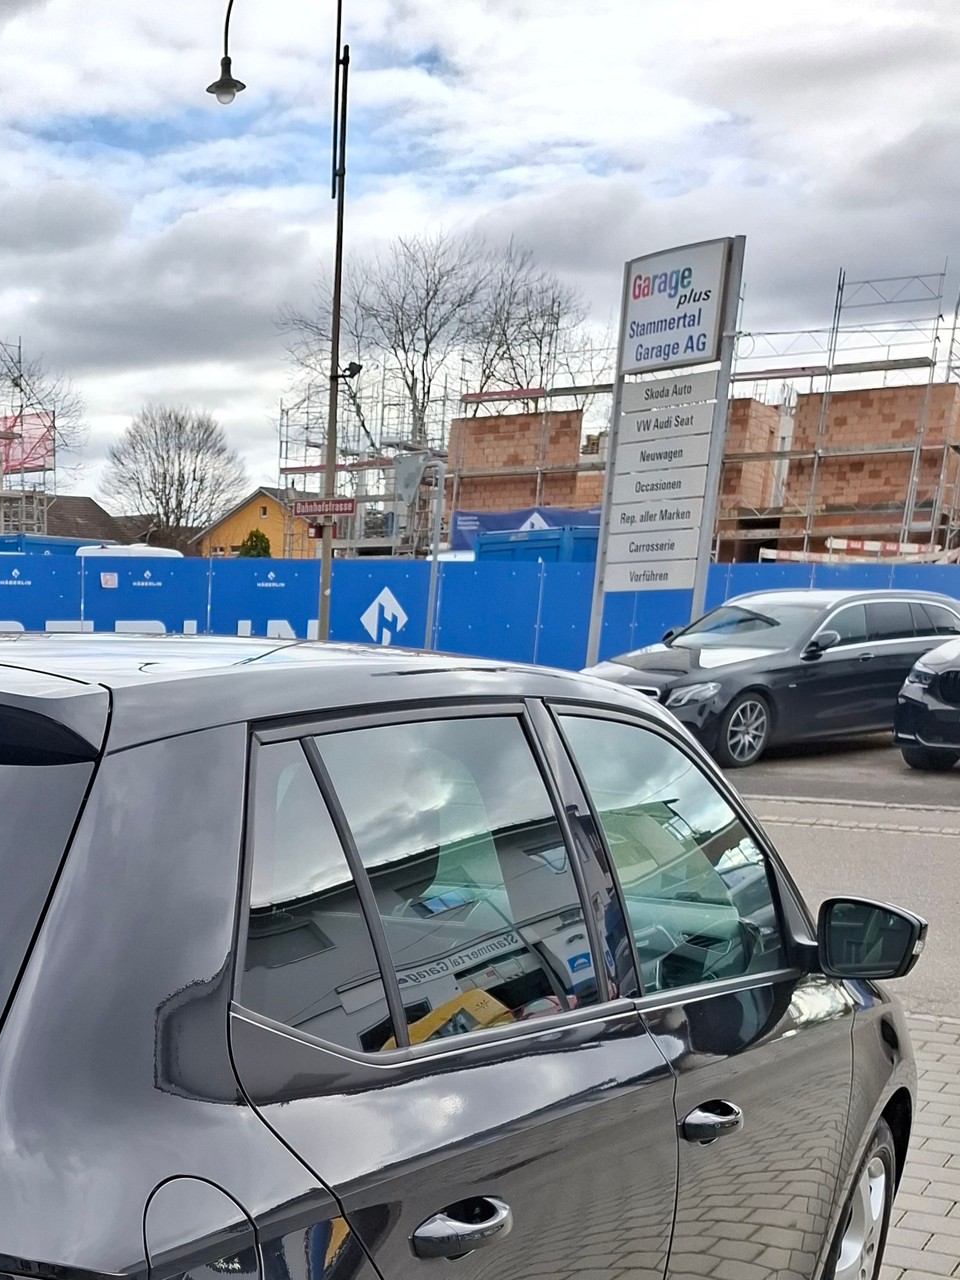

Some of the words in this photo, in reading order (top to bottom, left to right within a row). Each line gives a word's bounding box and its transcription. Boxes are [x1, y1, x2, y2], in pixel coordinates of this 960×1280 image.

[632, 266, 692, 300] Garage
[676, 288, 712, 309] plus
[629, 307, 702, 339] Stammertal
[635, 341, 679, 362] Garage
[683, 333, 707, 354] AG
[644, 385, 670, 400] Skoda
[671, 383, 692, 397] Auto
[636, 418, 652, 432] VW
[653, 416, 672, 430] Audi
[674, 414, 694, 428] Seat
[639, 448, 683, 463] Neuwagen
[635, 479, 682, 493] Occasionen
[296, 502, 353, 513] Bahnhofstrasse
[620, 512, 637, 525] Rep.
[639, 510, 658, 523] aller
[659, 508, 691, 521] Marken
[629, 540, 675, 554] Carrosserie
[629, 570, 669, 583] Vorführen
